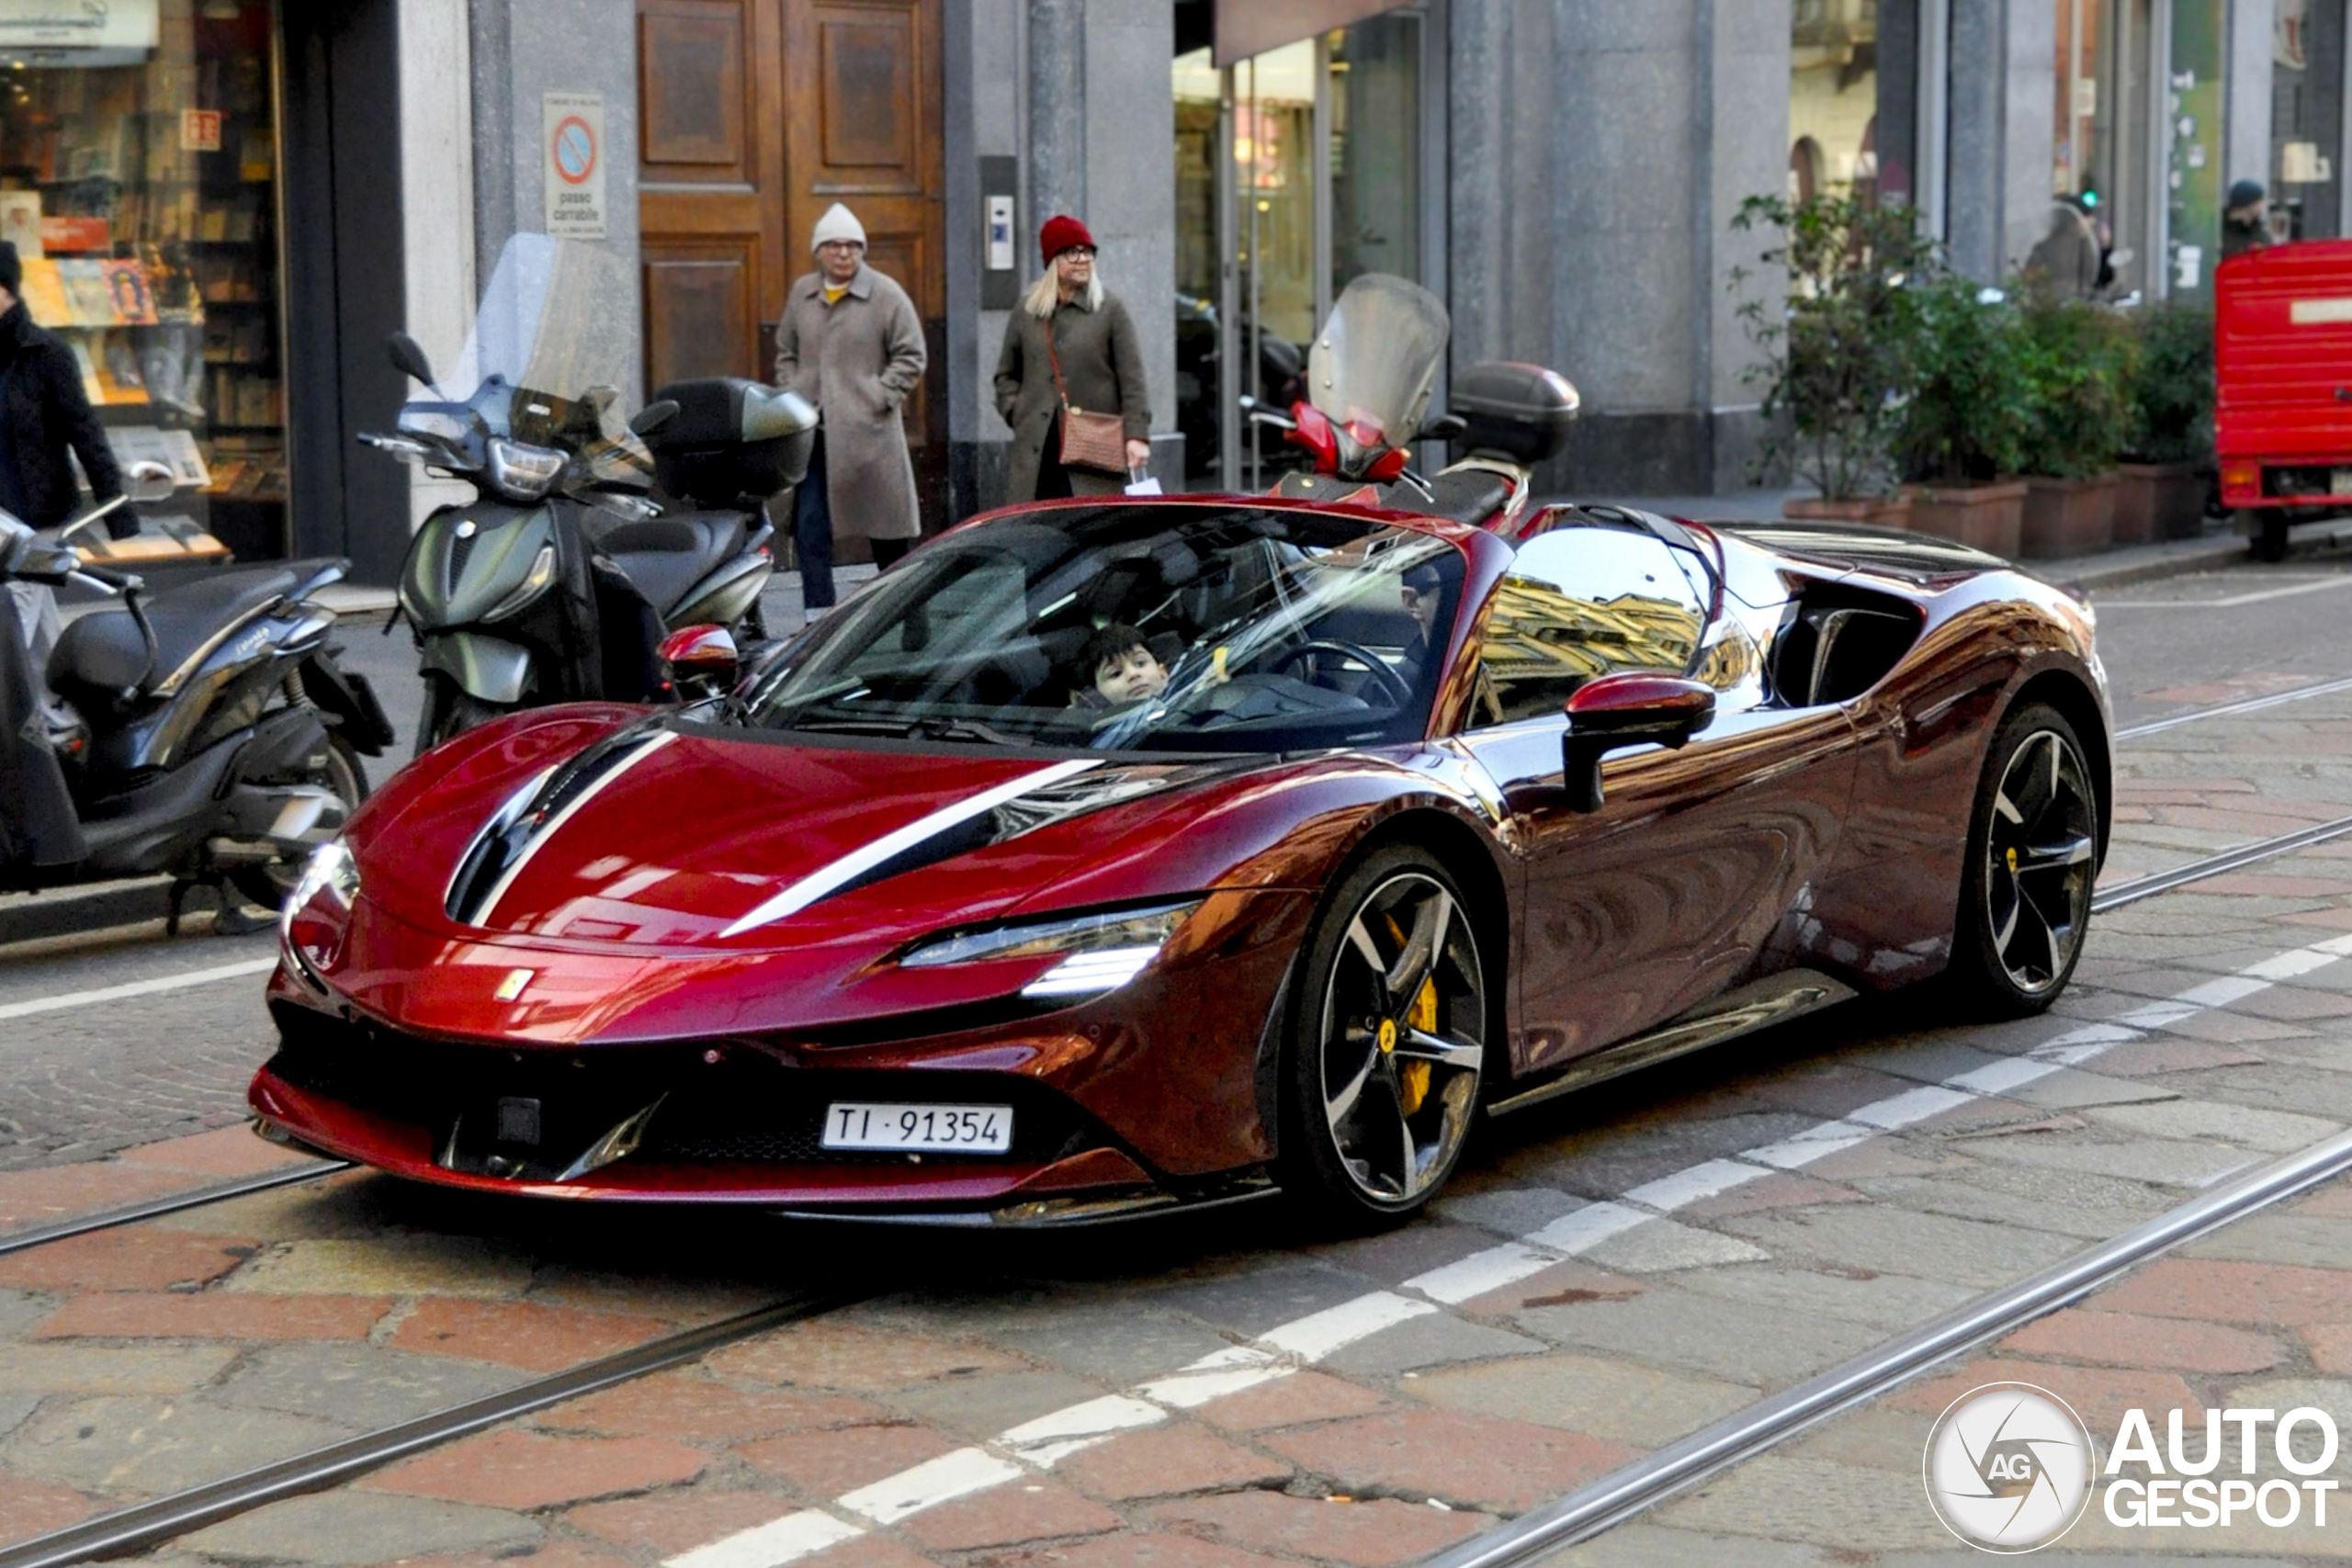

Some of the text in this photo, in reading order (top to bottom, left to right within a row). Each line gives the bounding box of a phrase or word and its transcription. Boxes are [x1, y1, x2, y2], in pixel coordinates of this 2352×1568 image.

[560, 192, 592, 206] passo
[553, 208, 599, 221] carrabile
[899, 1111, 998, 1144] 91354
